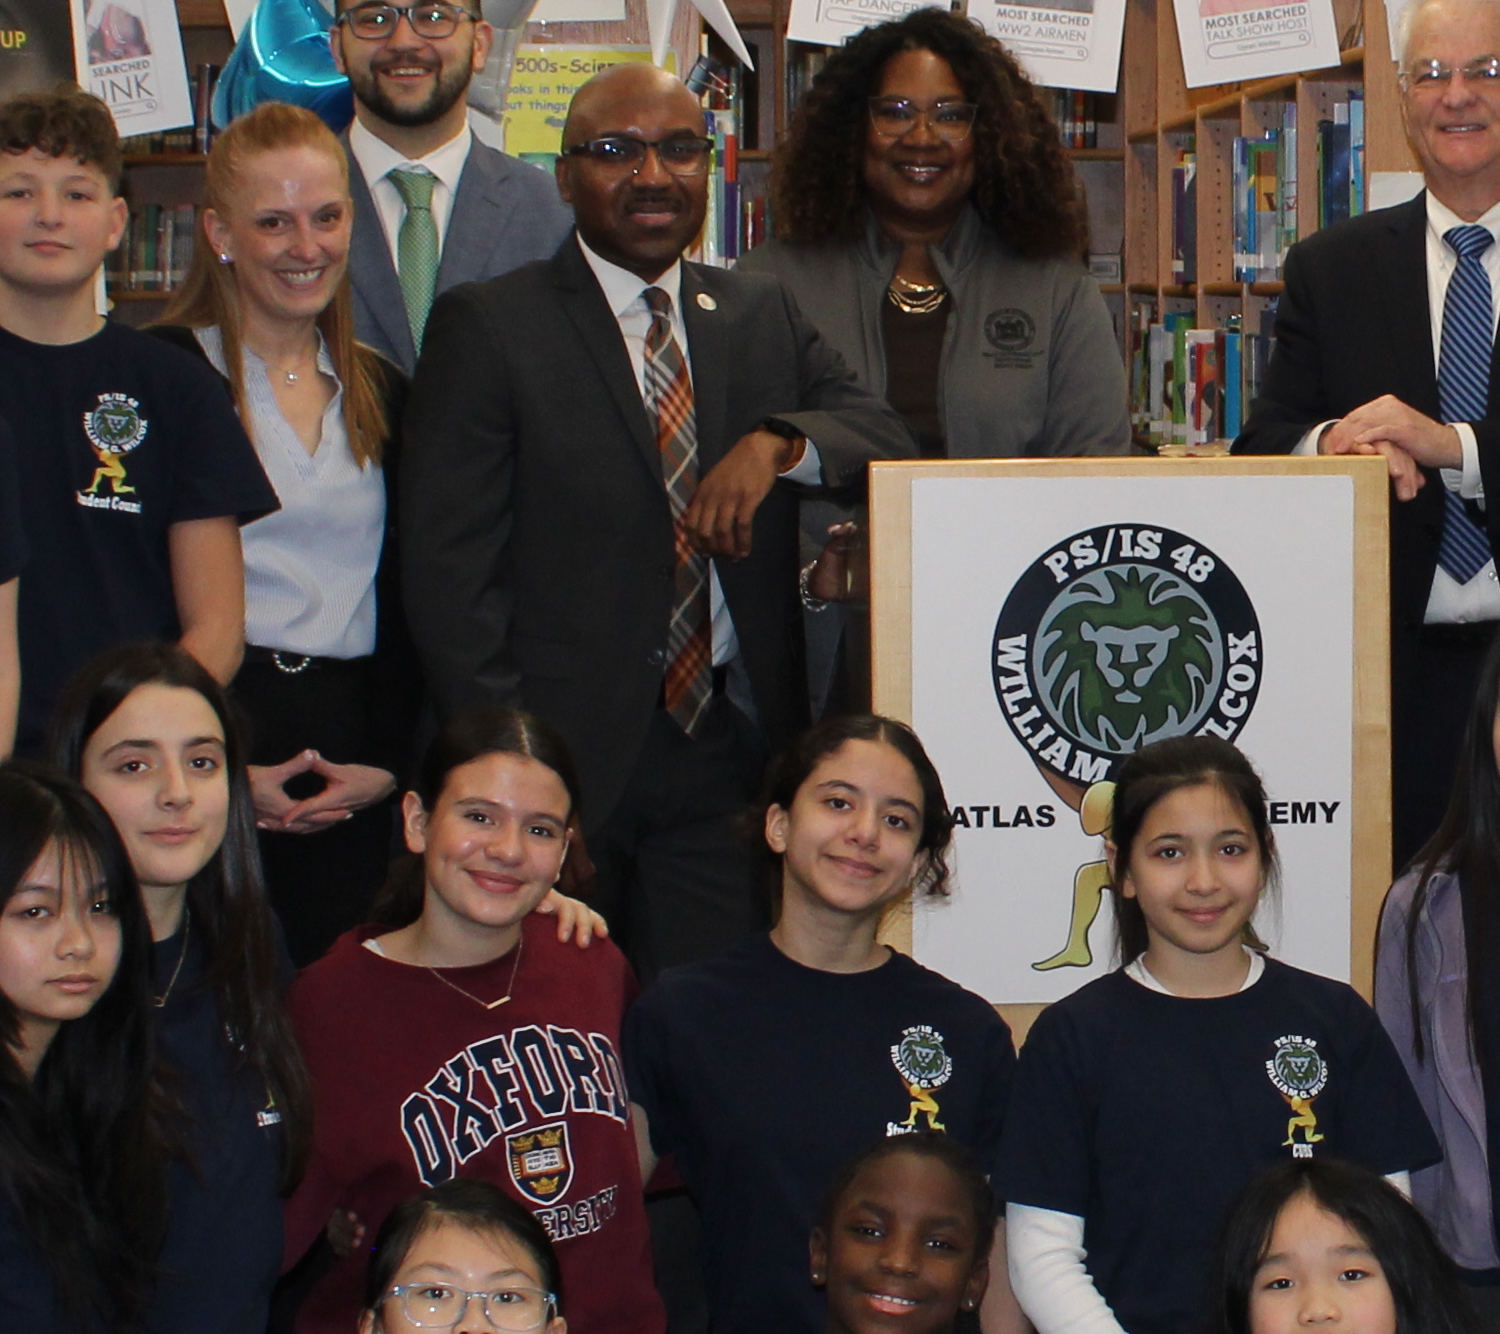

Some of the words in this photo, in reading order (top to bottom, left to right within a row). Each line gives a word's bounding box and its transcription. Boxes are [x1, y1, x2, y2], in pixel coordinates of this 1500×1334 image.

[996, 8, 1029, 21] MOST
[1030, 12, 1091, 27] SEARCHED
[1205, 15, 1240, 30] MOST
[1242, 5, 1307, 24] SEARCHED
[1206, 29, 1235, 42] TALK
[1237, 23, 1274, 38] SHOW
[1277, 16, 1309, 31] HOST
[1, 30, 27, 49] UP
[997, 22, 1032, 37] WW2
[1034, 27, 1087, 42] AIRMEN
[92, 59, 150, 77] SEARCHED
[83, 411, 110, 450] WILLIAM
[121, 418, 149, 453] WILCOX
[1043, 528, 1163, 584] PS/IS
[1169, 543, 1216, 584] 48
[996, 633, 1112, 784] WILLIAM
[949, 805, 1056, 828] ATLAS
[890, 1044, 920, 1085] WILLIAM
[1265, 1059, 1298, 1098] WILLIAM
[1309, 1059, 1329, 1097] WILCOX
[400, 1023, 630, 1188] OXFORD
